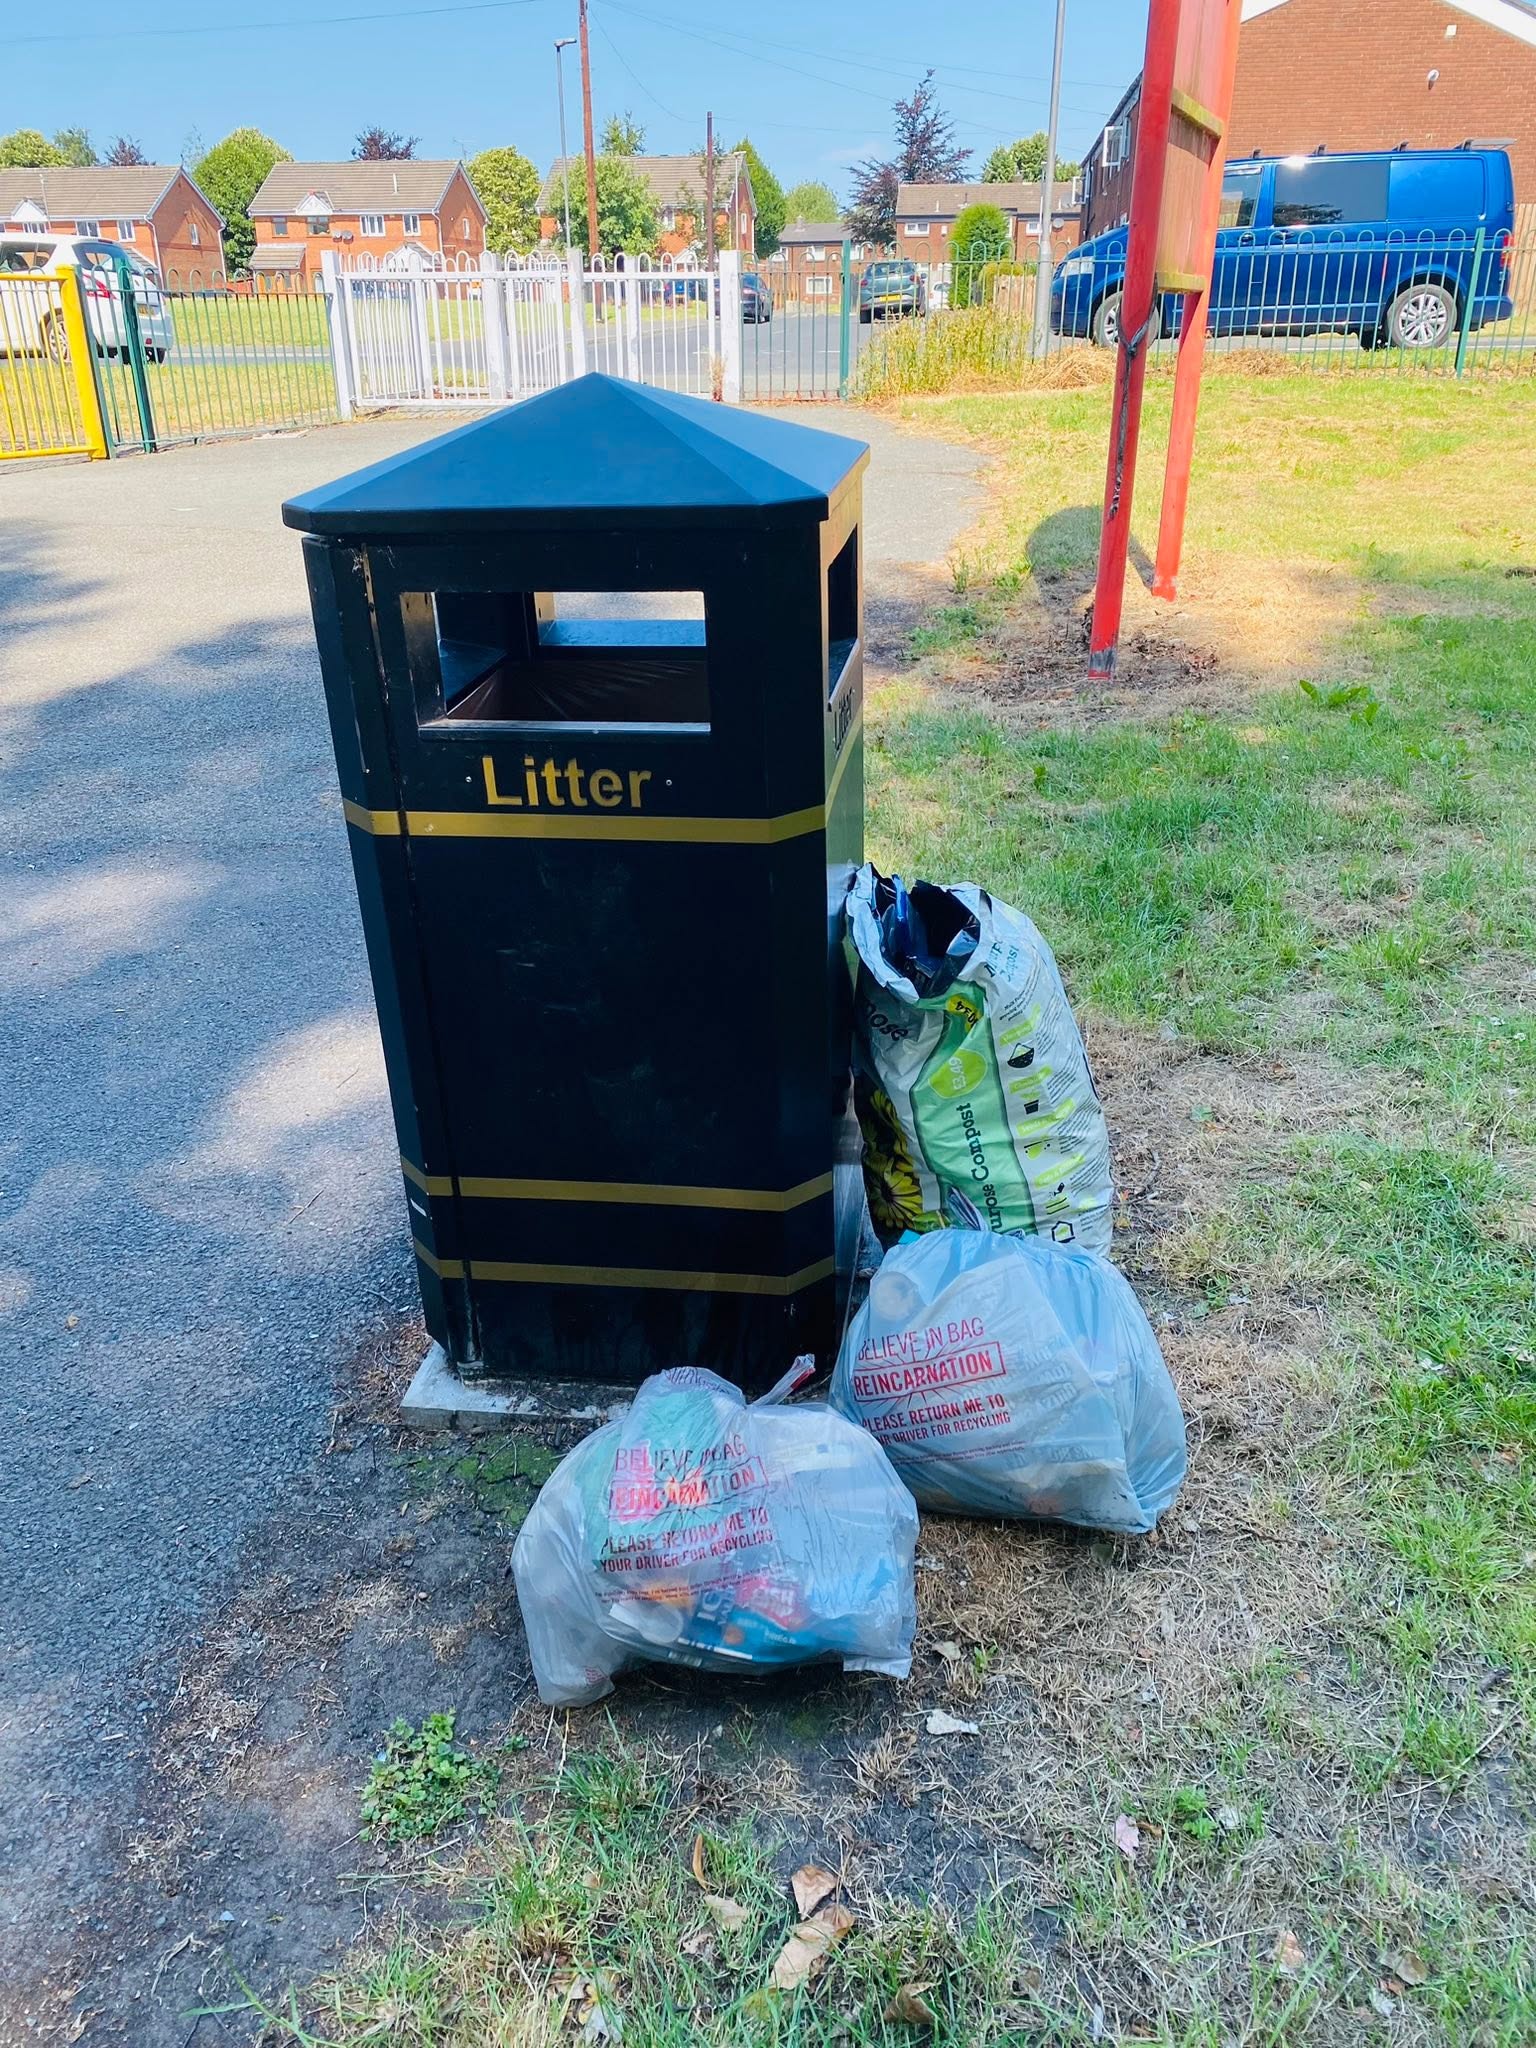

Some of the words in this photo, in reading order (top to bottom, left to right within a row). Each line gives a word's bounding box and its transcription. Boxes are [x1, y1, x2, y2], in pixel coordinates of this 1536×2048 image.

[834, 687, 853, 751] Litter
[482, 754, 652, 808] Litter
[956, 1102, 990, 1182] Compost
[983, 1184, 1003, 1232] urpose
[925, 1326, 944, 1350] IN
[947, 1317, 985, 1344] BAG
[853, 1350, 992, 1397] REINCARNATION
[862, 1412, 907, 1432] PLEASE
[909, 1402, 961, 1425] RETURN
[964, 1397, 985, 1415] ME
[986, 1393, 1005, 1409] TO
[894, 1427, 929, 1443] DRIVER
[931, 1423, 952, 1437] FOR
[954, 1411, 1011, 1433] RECYCLING
[749, 1506, 769, 1526] TO
[600, 1558, 632, 1573] YOUR
[636, 1553, 679, 1570] DRIVER
[710, 1529, 774, 1557] RECYCLING
